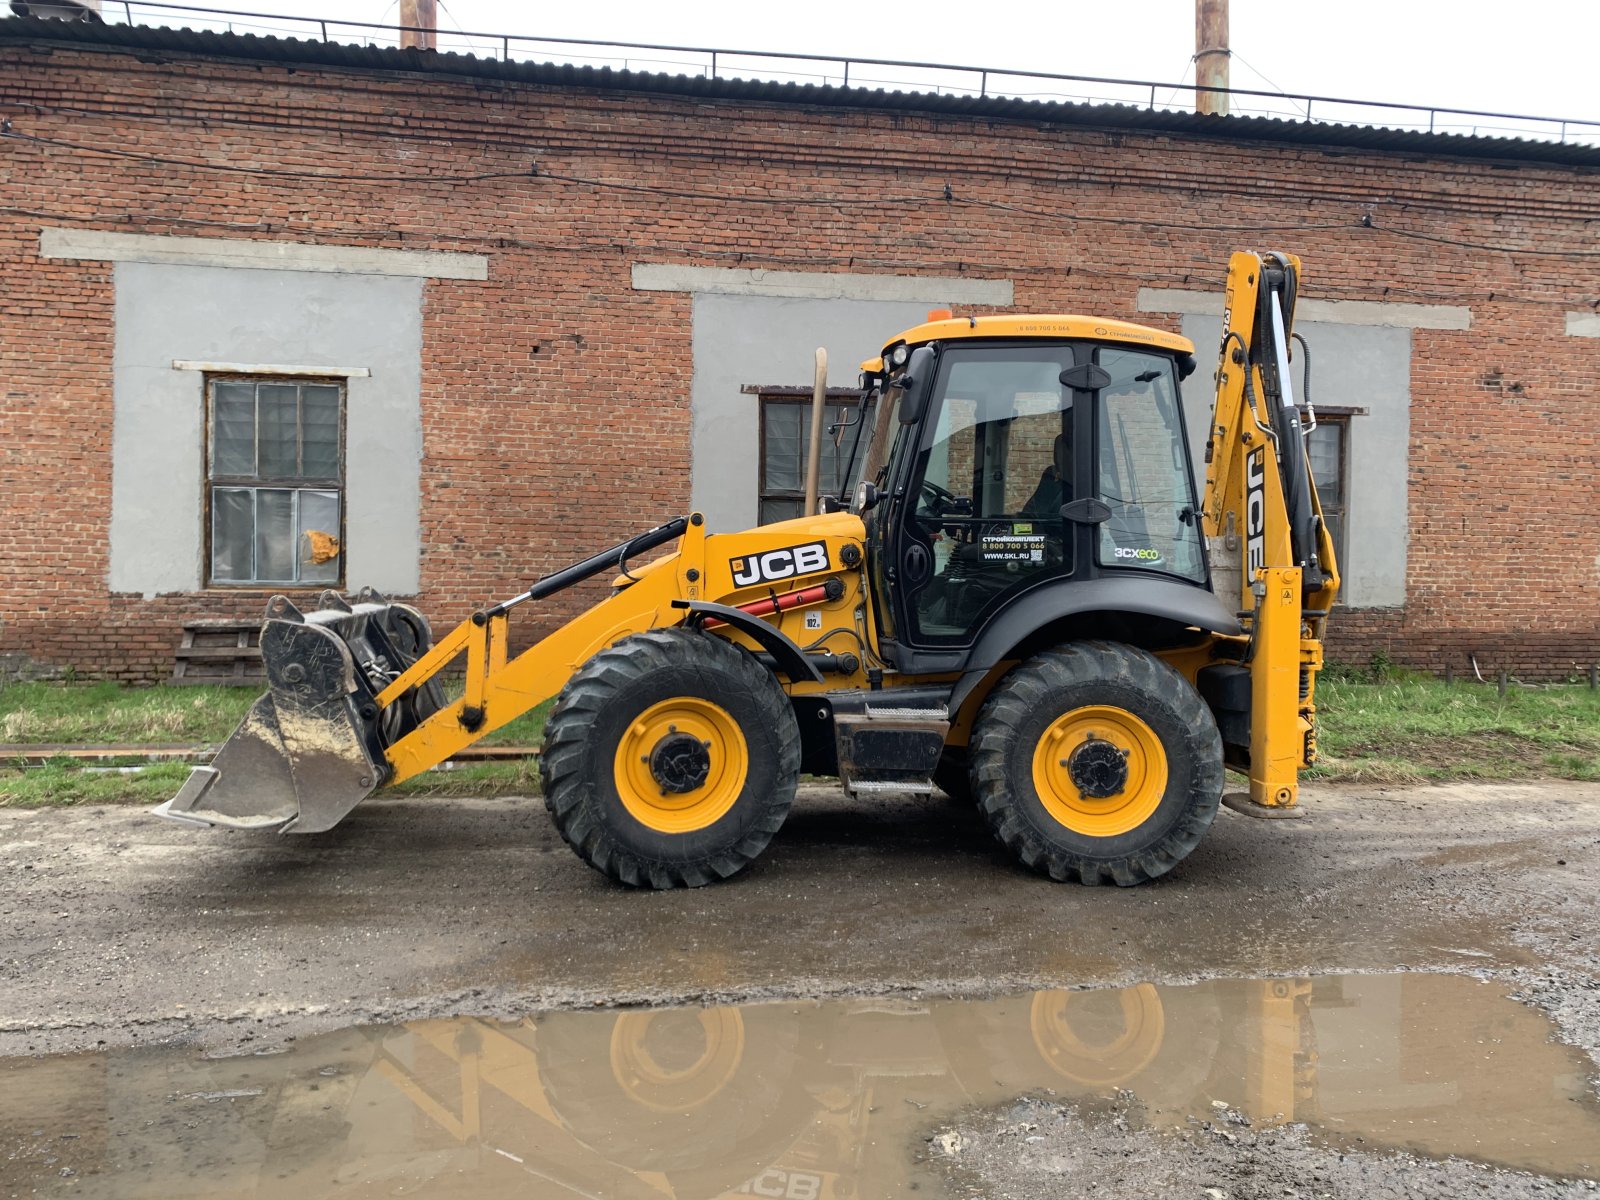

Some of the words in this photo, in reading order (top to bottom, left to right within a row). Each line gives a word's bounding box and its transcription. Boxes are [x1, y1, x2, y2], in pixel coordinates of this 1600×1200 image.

[1247, 452, 1264, 583] JCB
[734, 544, 828, 586] JCB
[806, 618, 817, 628] 102
